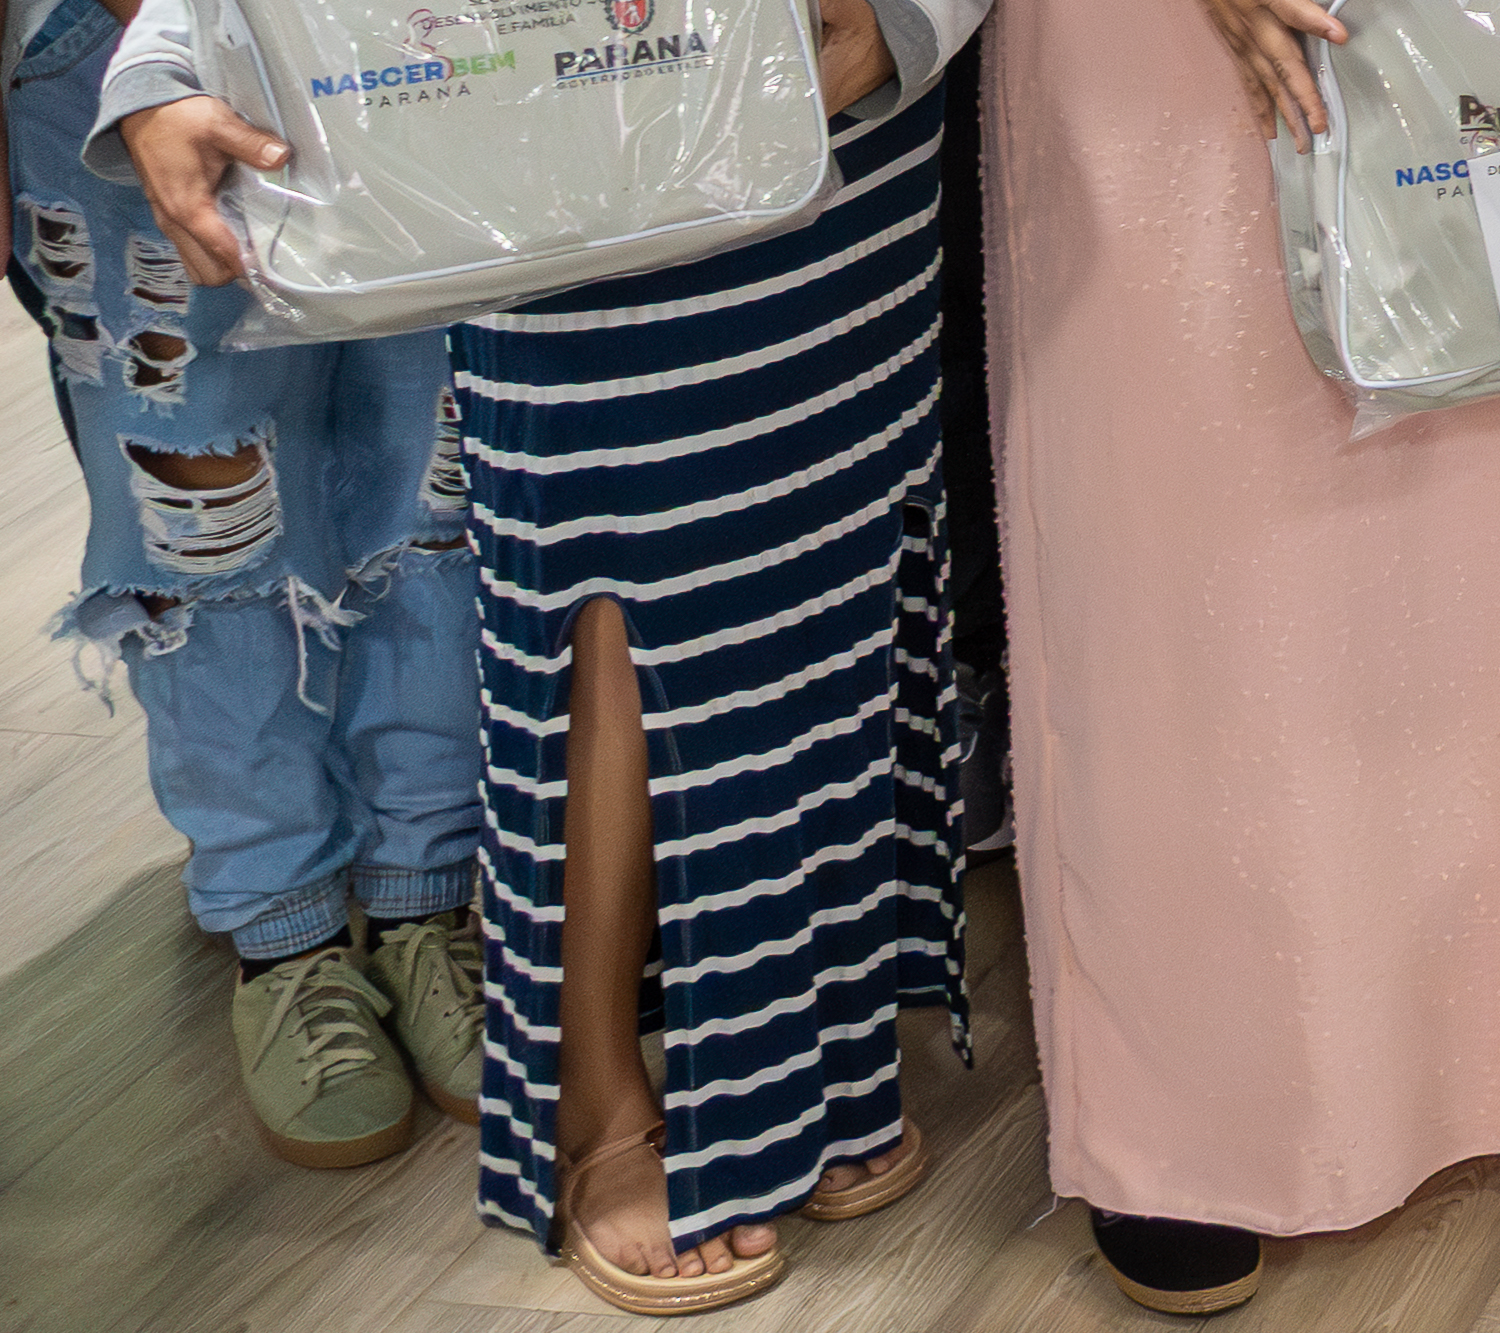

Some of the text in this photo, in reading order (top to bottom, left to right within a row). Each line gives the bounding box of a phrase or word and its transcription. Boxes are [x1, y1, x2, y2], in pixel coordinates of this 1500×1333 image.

[310, 49, 517, 98] NASCER BEM
[1395, 160, 1470, 187] NASC
